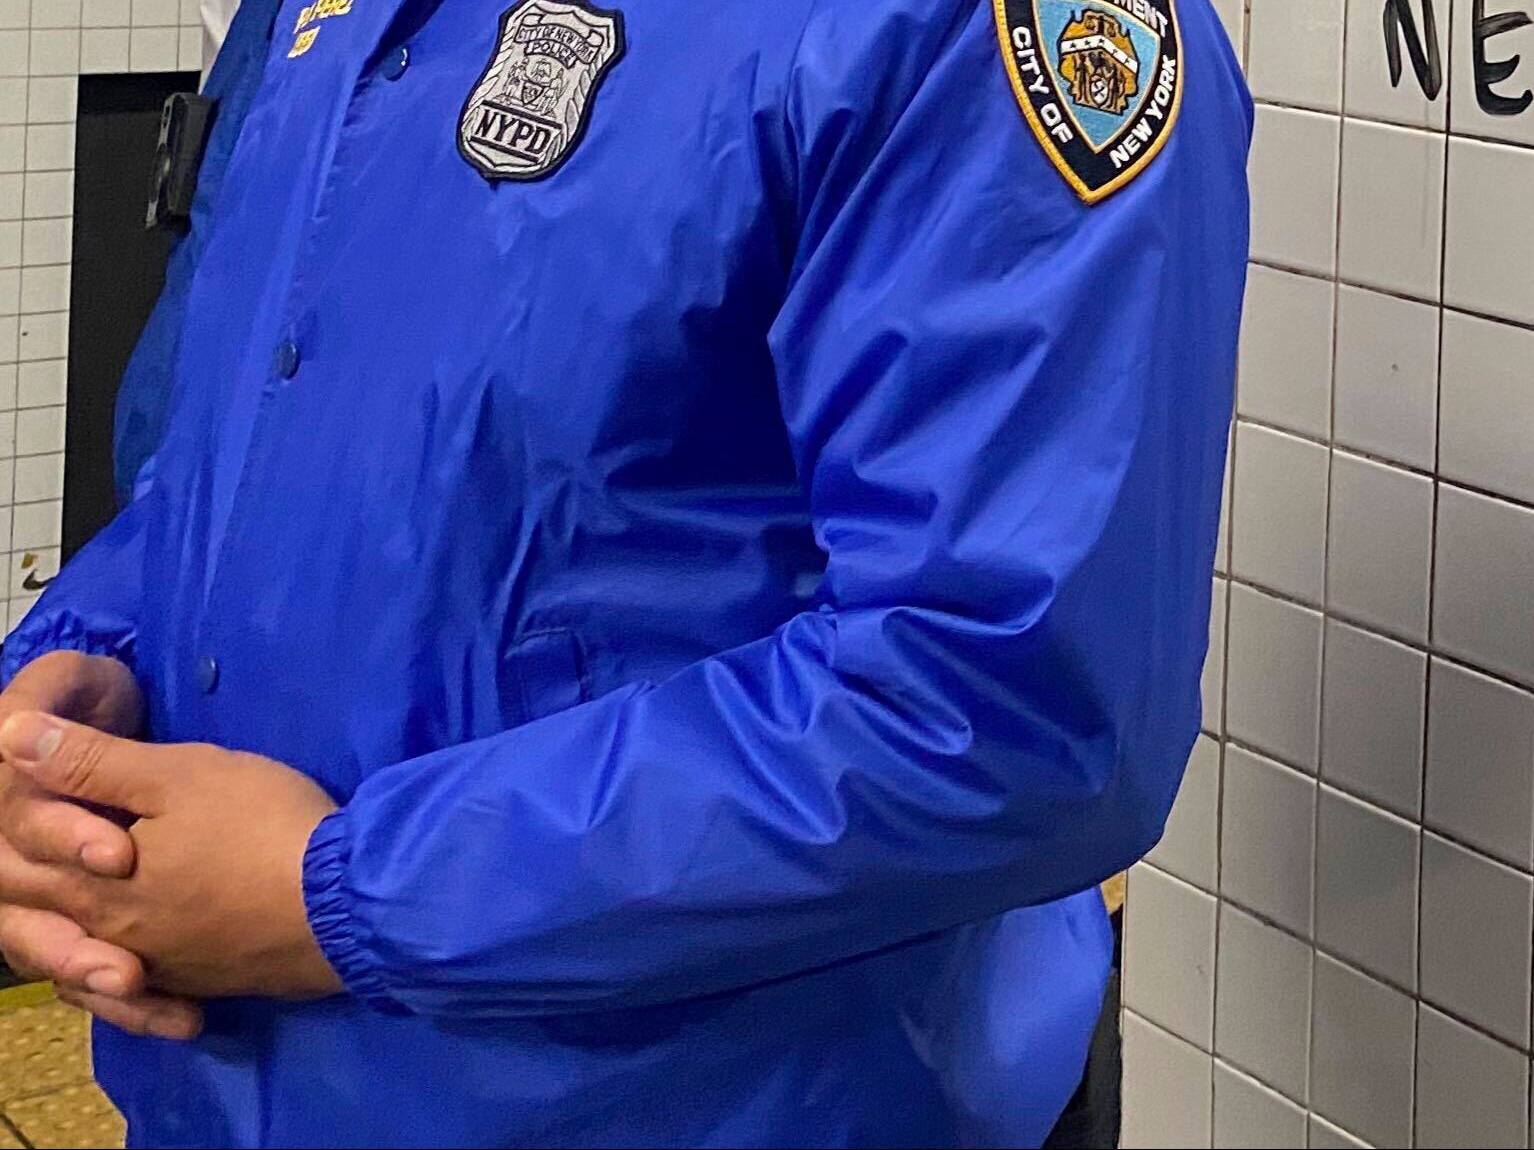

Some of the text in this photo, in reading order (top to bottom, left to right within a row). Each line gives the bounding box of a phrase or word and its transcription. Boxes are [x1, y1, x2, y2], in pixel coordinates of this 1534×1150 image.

[531, 41, 575, 61] POLICE
[1012, 25, 1176, 168] CITY OF NEW YORK
[476, 108, 551, 154] NYPD
